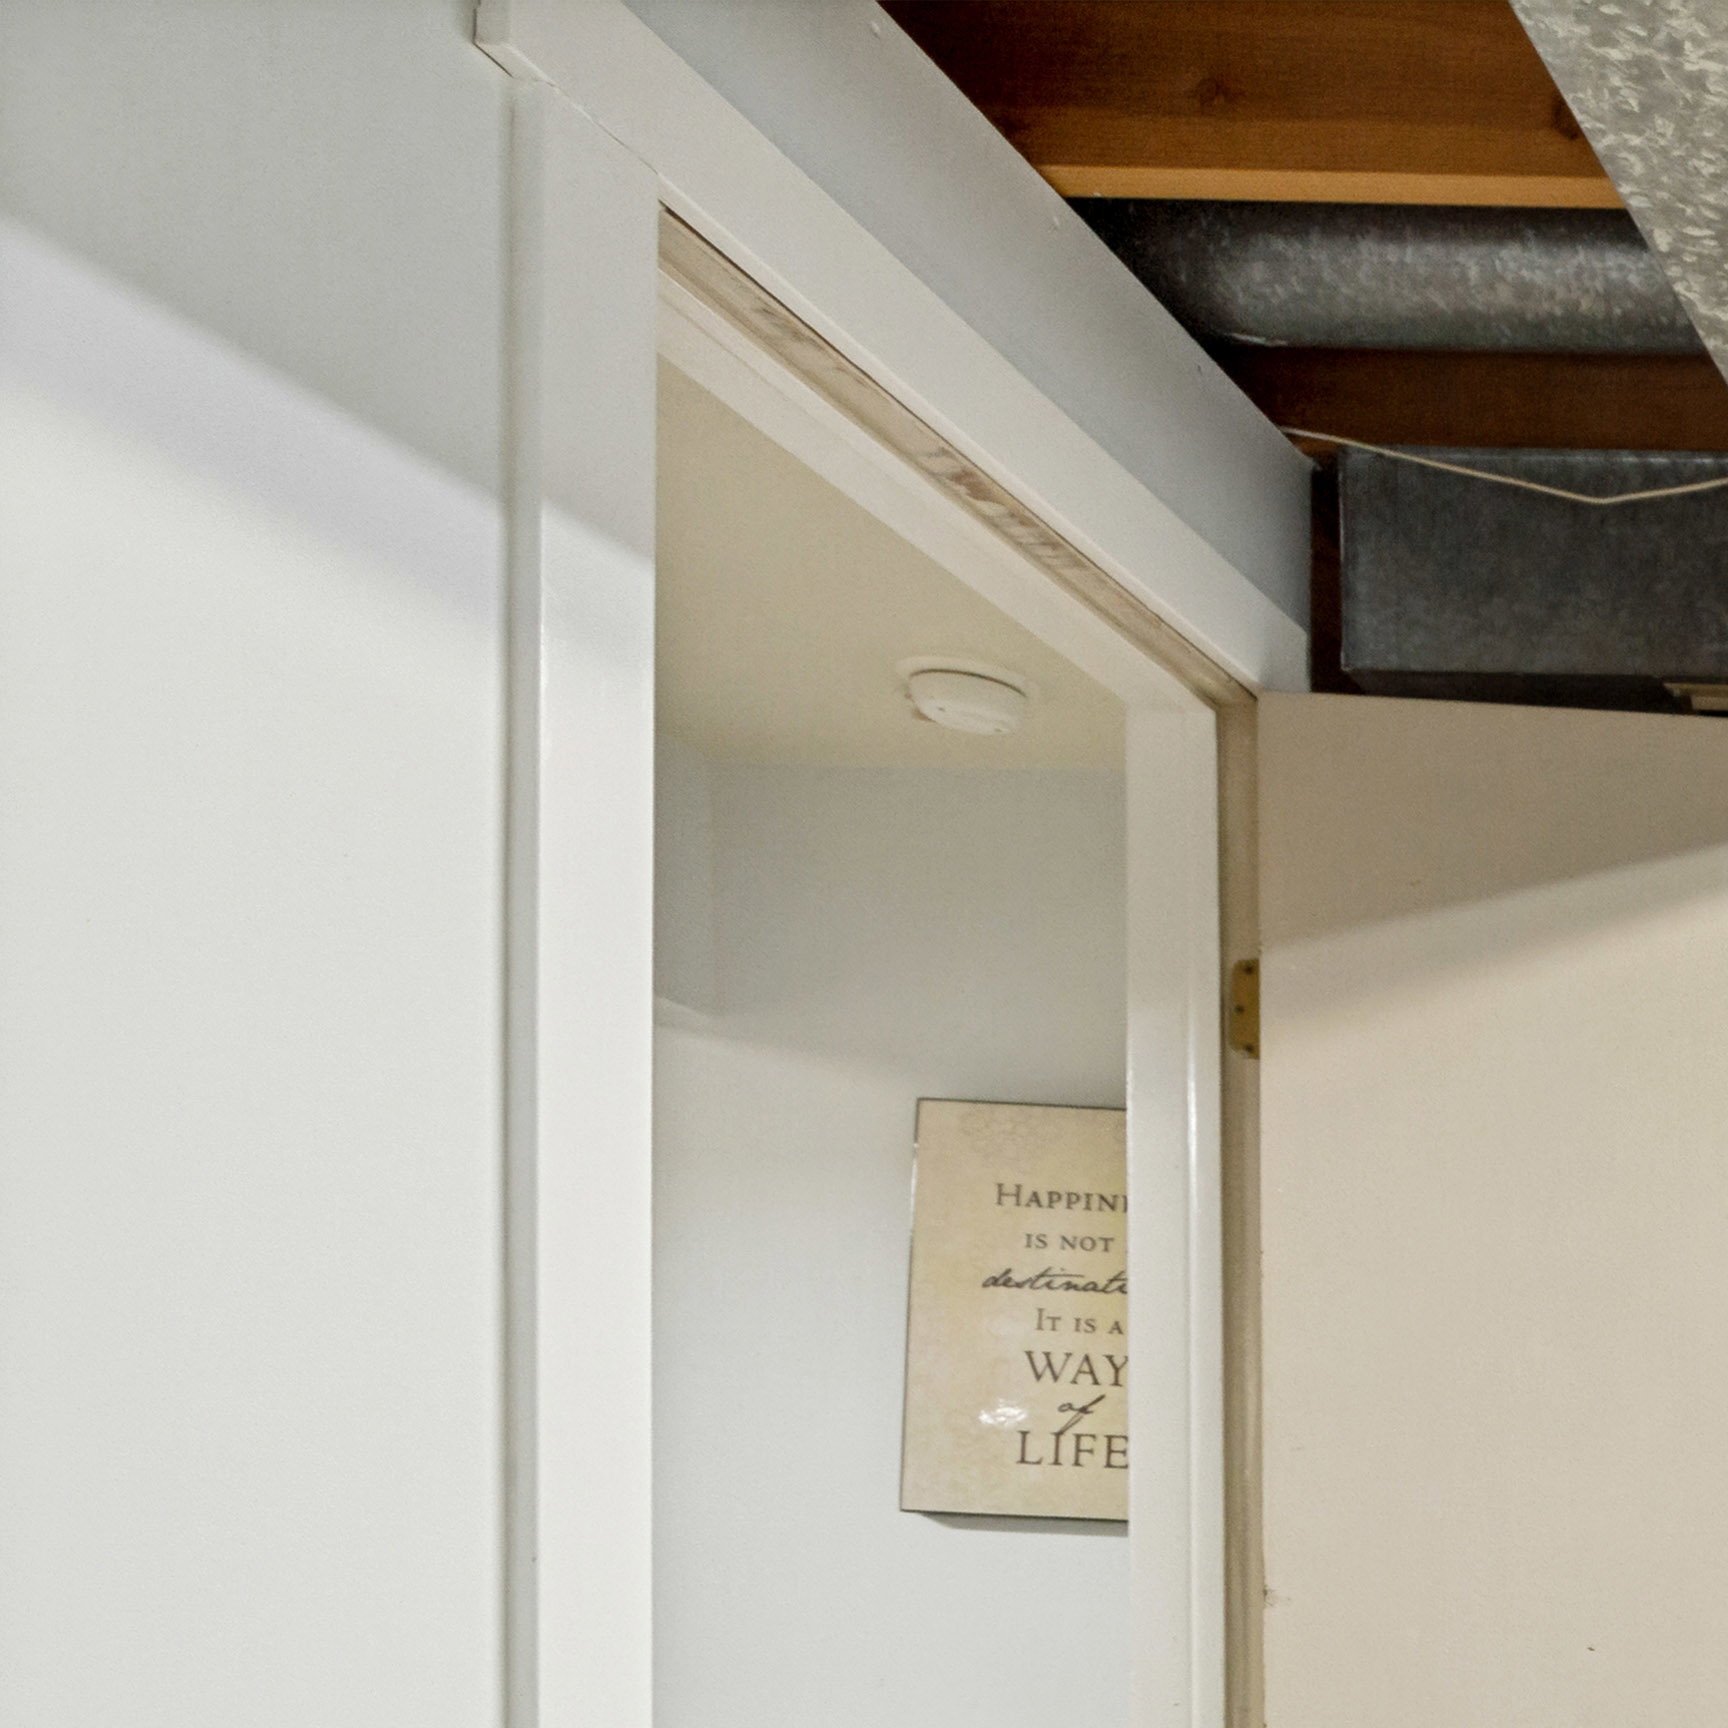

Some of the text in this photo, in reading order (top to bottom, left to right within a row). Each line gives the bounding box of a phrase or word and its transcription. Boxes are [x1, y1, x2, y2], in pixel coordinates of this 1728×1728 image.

[995, 1183, 1127, 1213] HAPPIN
[1025, 1233, 1115, 1253] IS NOT
[1024, 1350, 1128, 1388] WAY
[1057, 1394, 1107, 1436] of
[1016, 1430, 1128, 1470] LIFE
